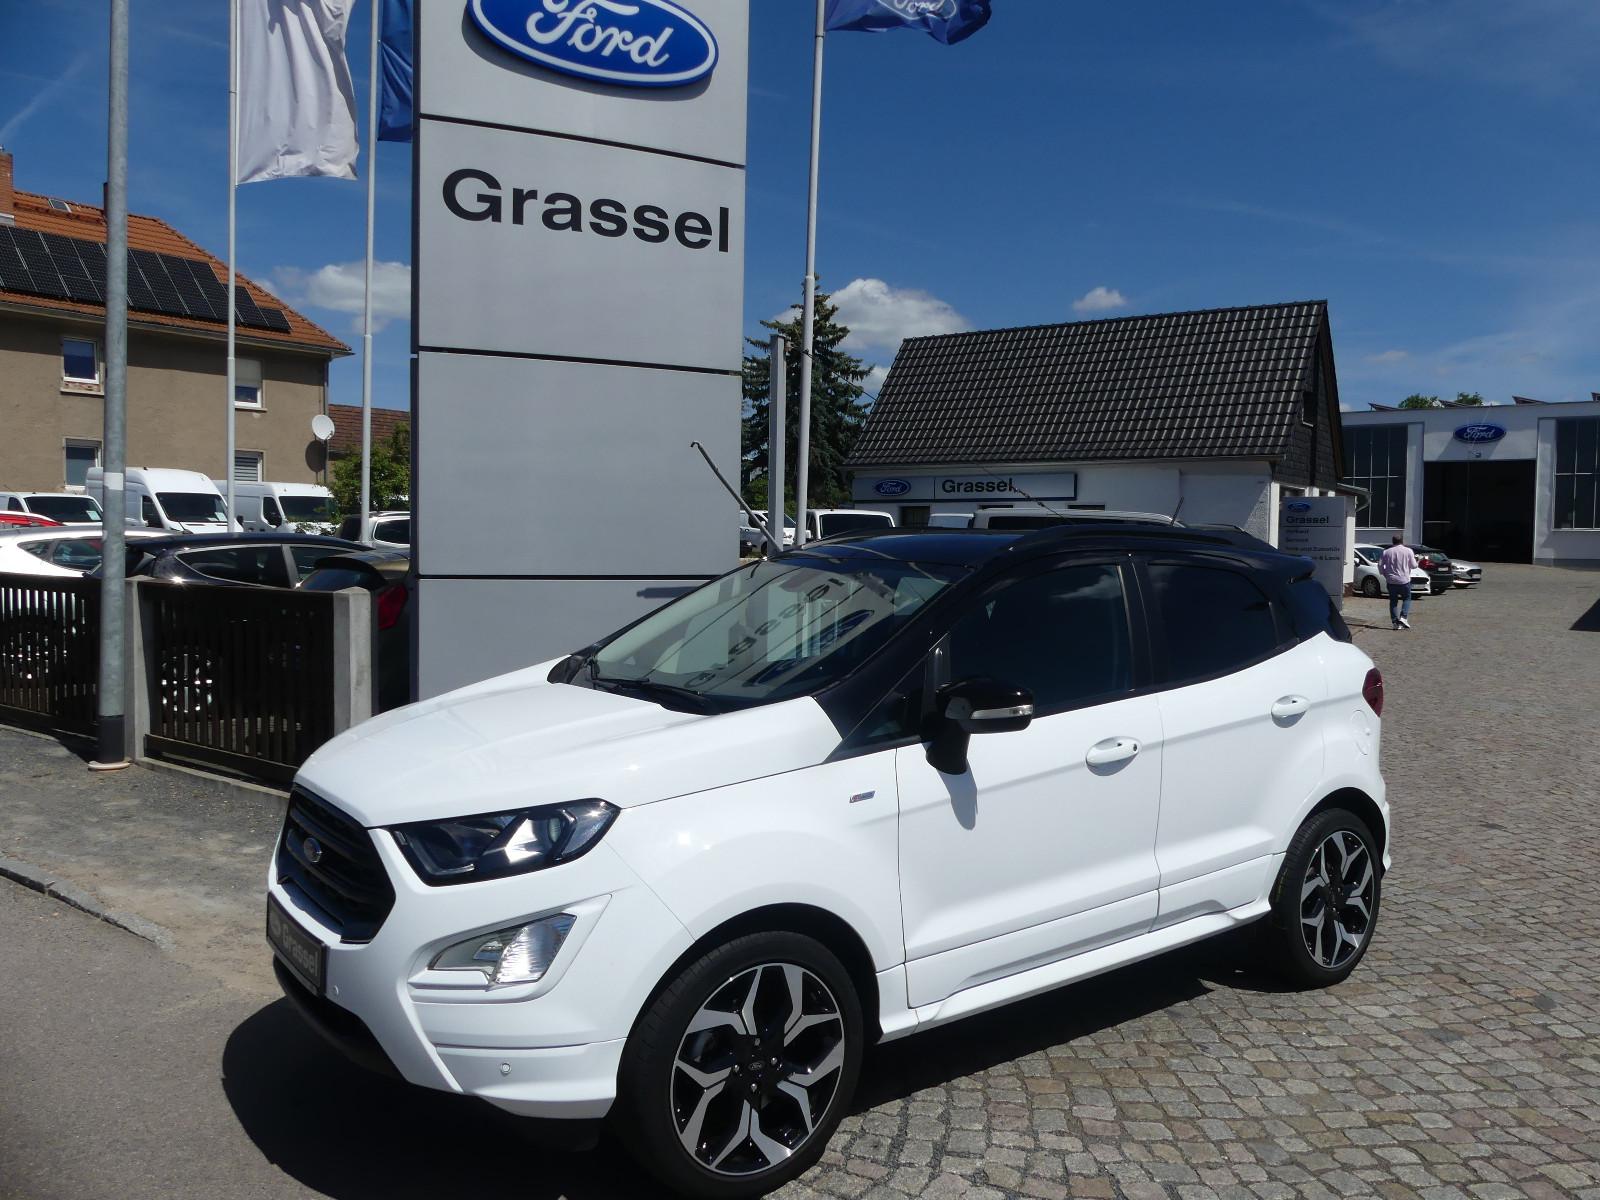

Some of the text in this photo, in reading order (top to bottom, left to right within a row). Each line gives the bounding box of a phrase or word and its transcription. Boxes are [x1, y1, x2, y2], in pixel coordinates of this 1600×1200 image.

[525, 0, 674, 67] Ford
[441, 168, 729, 253] Grassel
[1463, 426, 1496, 440] Ford
[941, 477, 1013, 493] Grassel
[1286, 515, 1329, 524] Grassel
[282, 923, 318, 977] Grassel
